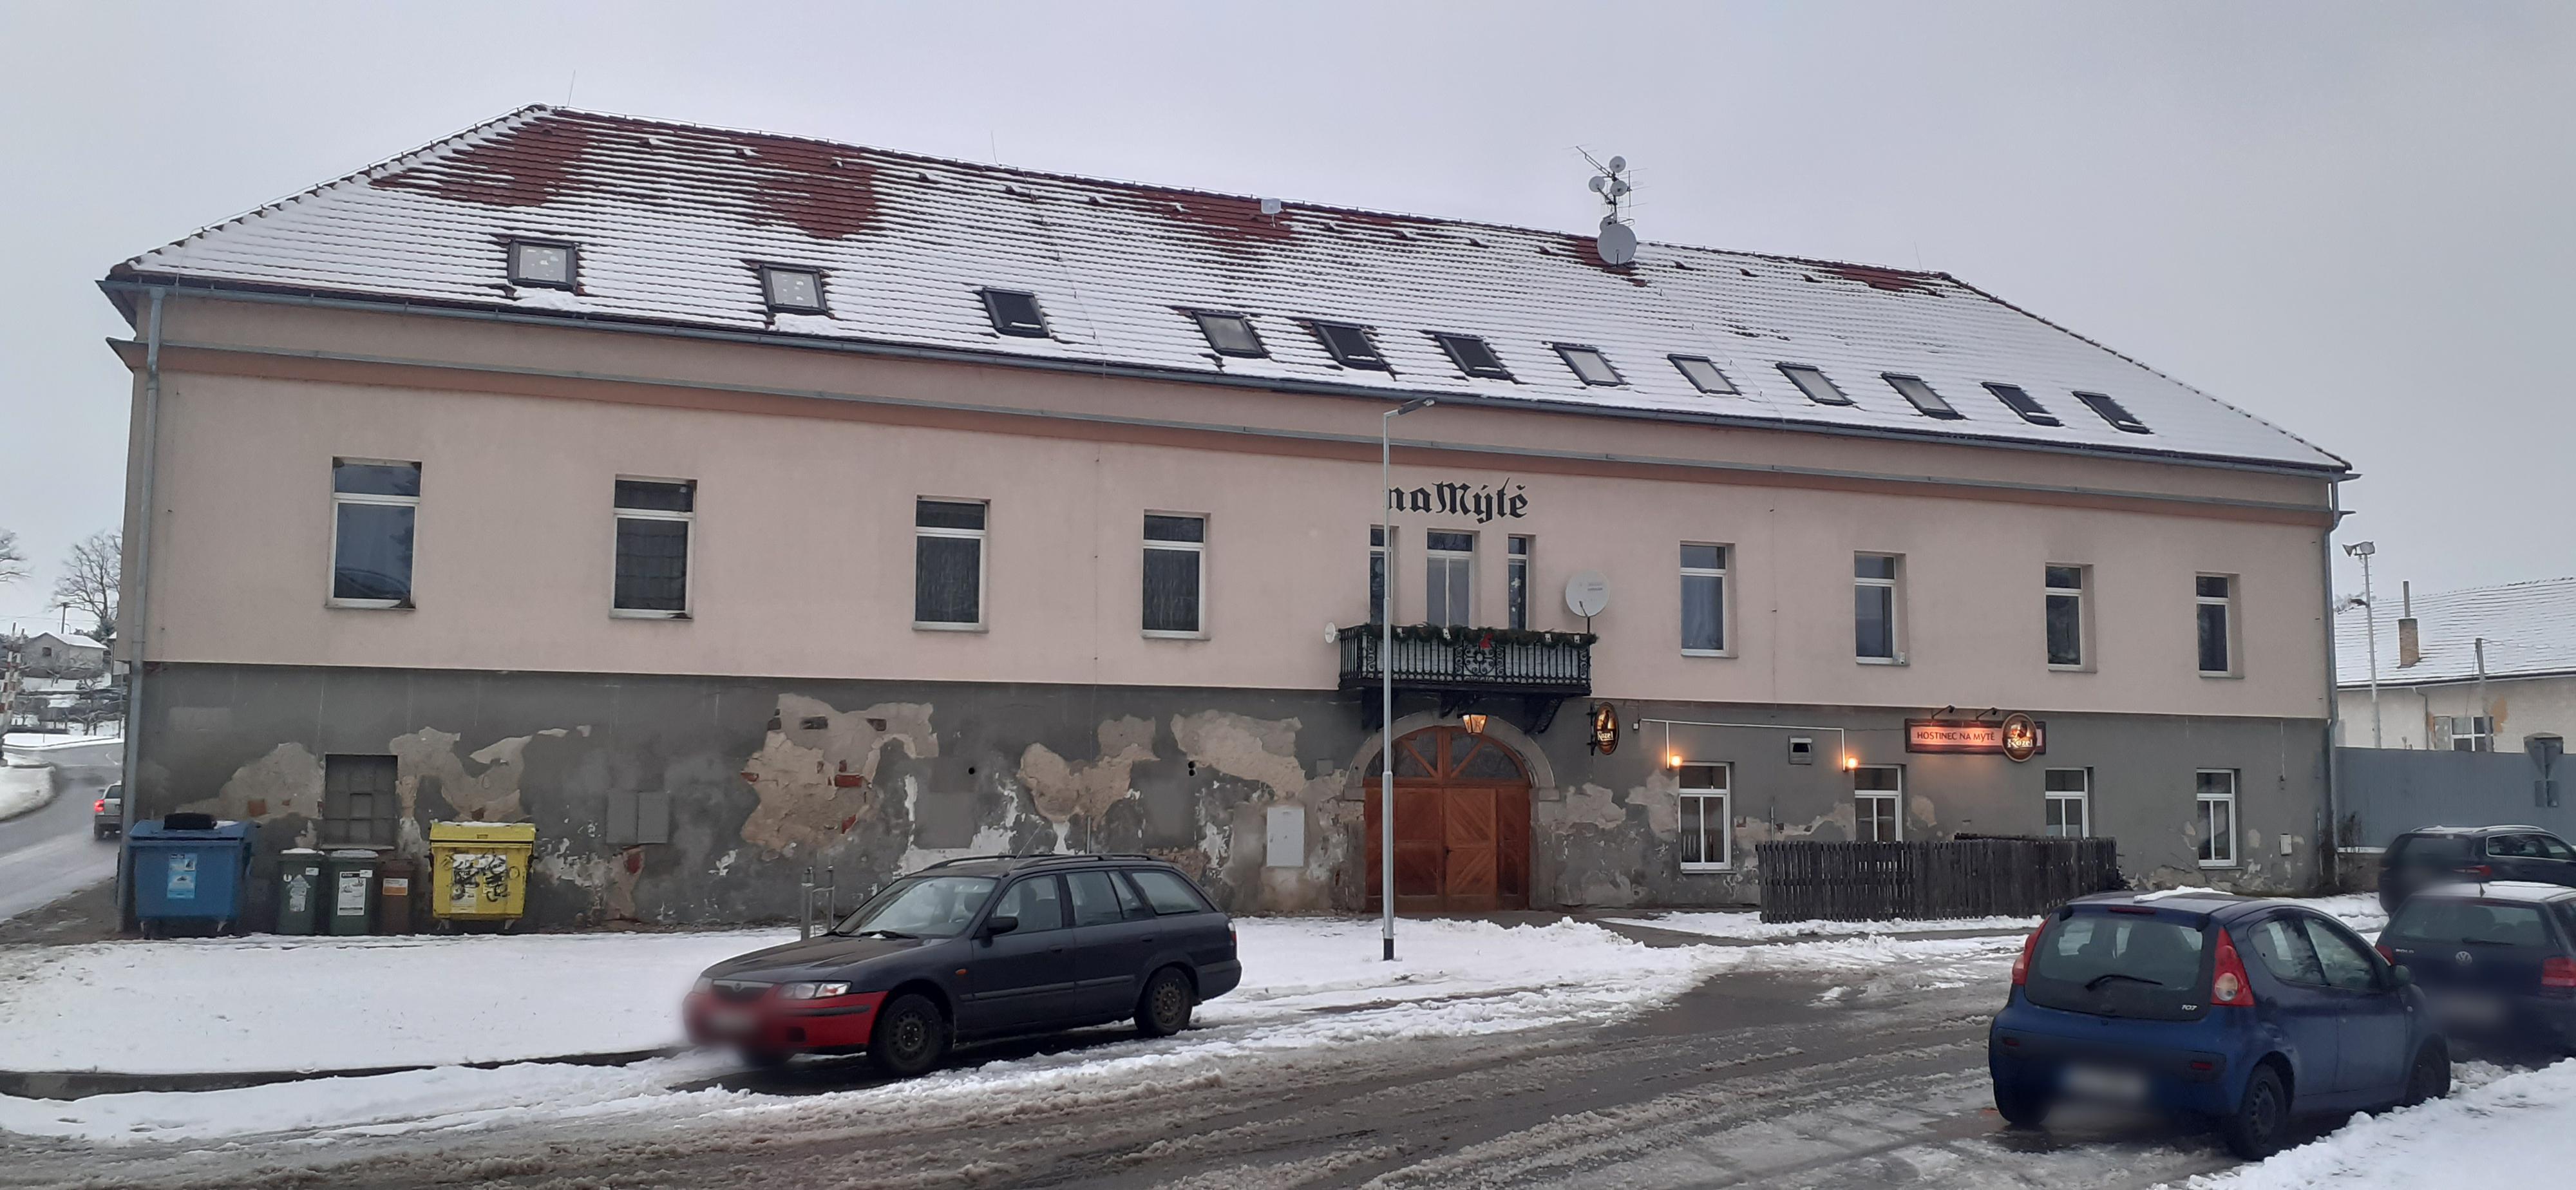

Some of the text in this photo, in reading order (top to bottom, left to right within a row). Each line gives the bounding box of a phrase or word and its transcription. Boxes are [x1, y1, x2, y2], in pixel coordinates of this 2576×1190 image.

[1597, 731, 1614, 741] Kozel
[1917, 732, 1957, 741] HOSTINEC
[1959, 732, 1971, 741] NA
[2007, 739, 2033, 748] Kozel
